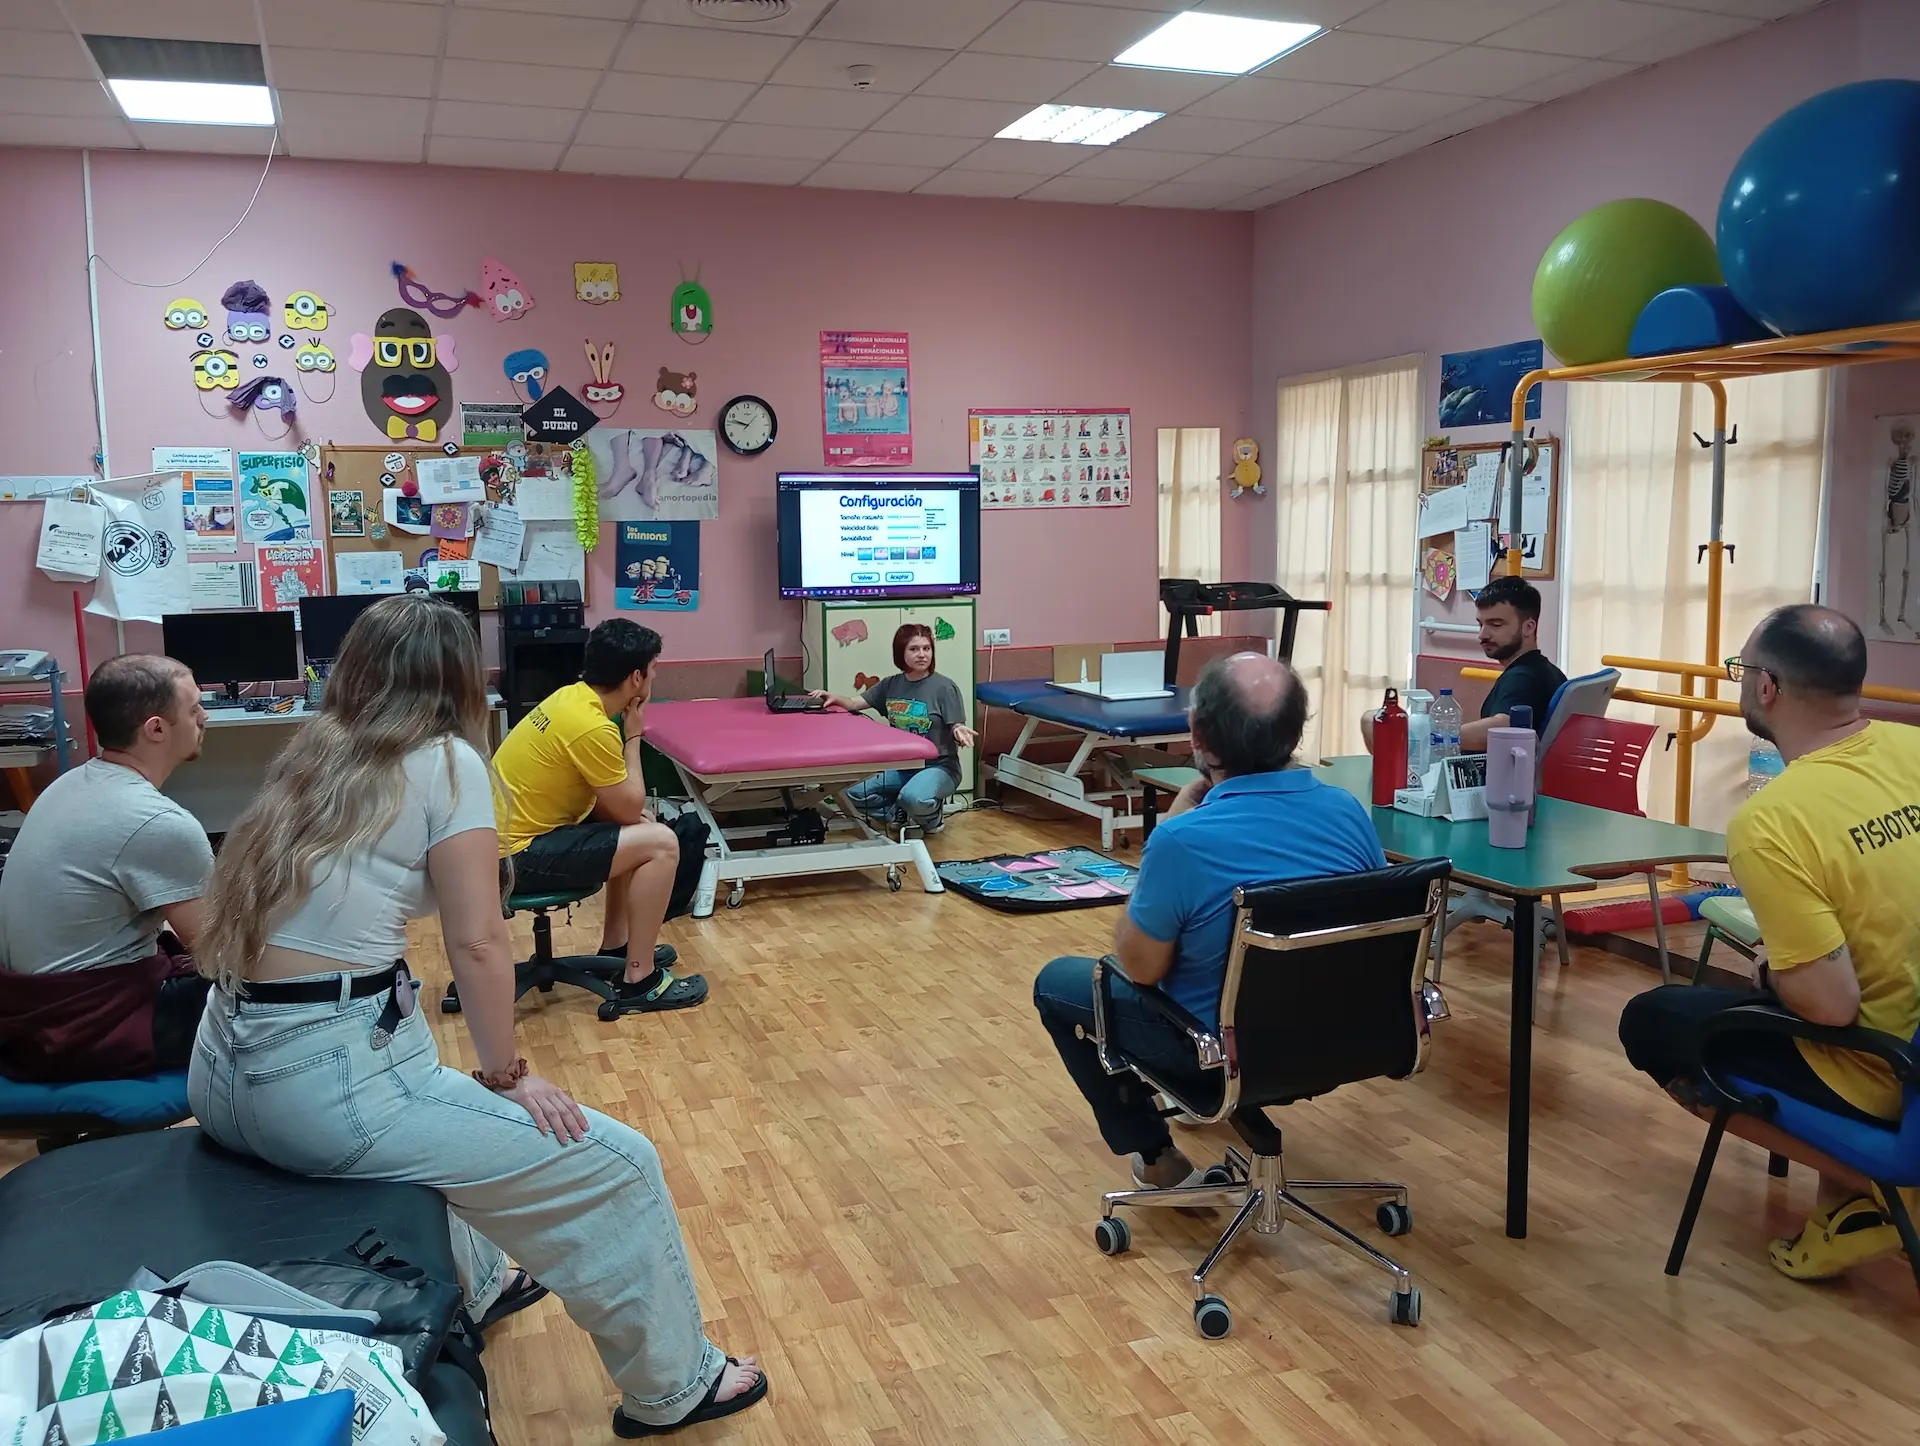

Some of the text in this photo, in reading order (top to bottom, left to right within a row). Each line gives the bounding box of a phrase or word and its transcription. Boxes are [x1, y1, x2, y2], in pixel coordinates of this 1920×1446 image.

[553, 408, 566, 417] EL
[542, 421, 578, 430] BUENO
[840, 494, 922, 510] Configuración
[212, 1389, 226, 1416] nglés
[160, 1400, 173, 1430] nglés
[106, 1412, 119, 1441] nglés
